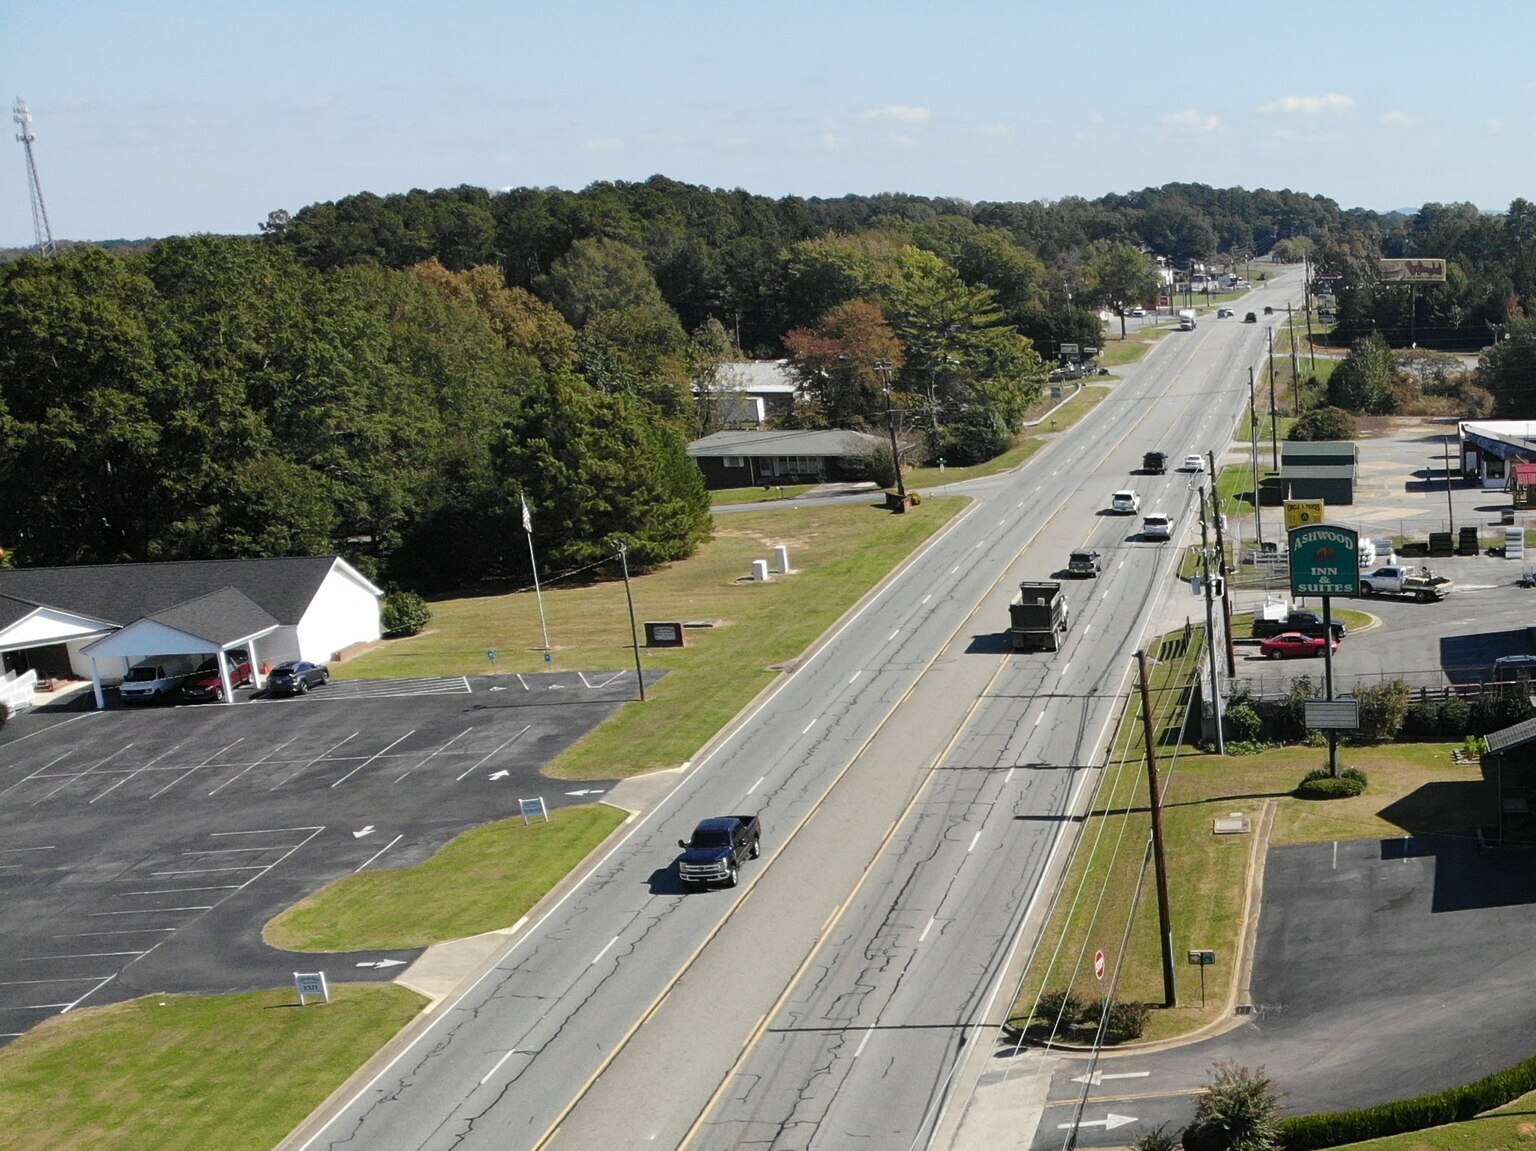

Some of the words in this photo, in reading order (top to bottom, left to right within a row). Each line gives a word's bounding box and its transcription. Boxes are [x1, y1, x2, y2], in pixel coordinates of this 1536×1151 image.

[1294, 531, 1353, 551] ASHWOOD
[1311, 567, 1338, 576] INN
[1318, 576, 1330, 584] &
[1298, 583, 1353, 592] SUITES
